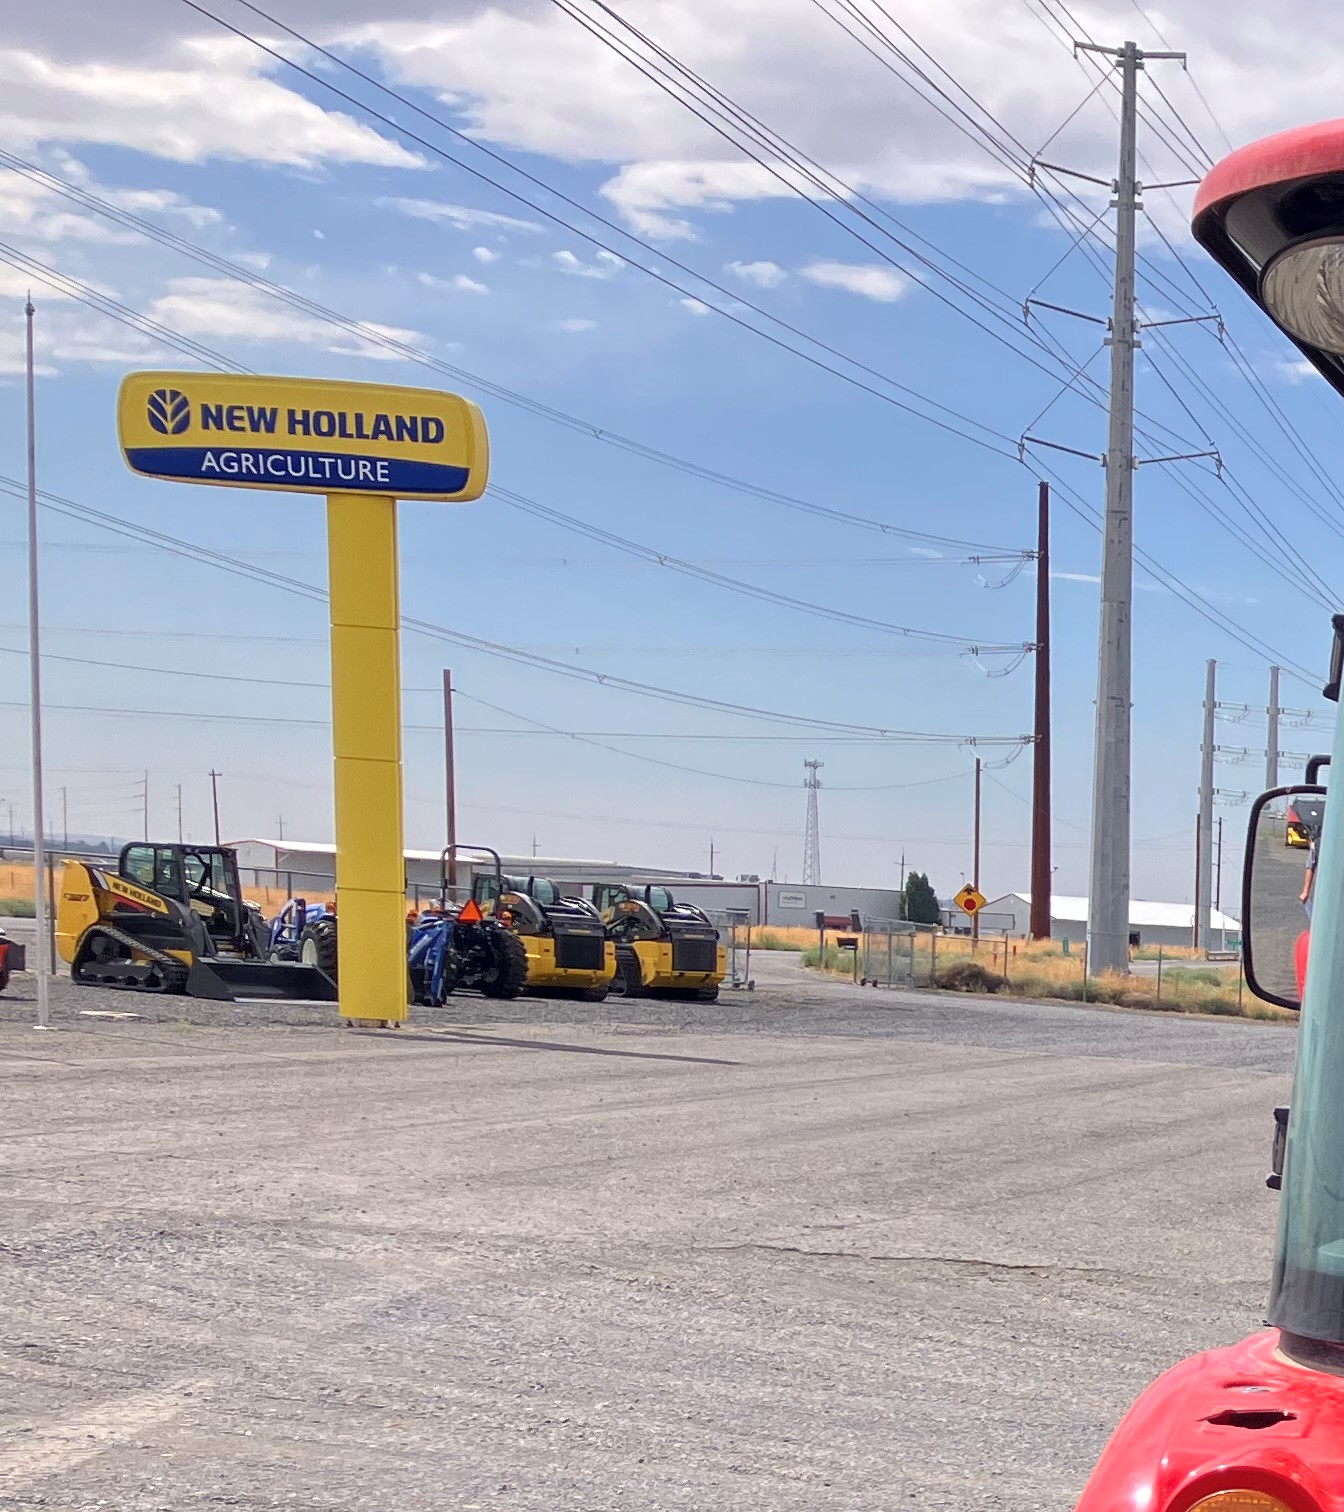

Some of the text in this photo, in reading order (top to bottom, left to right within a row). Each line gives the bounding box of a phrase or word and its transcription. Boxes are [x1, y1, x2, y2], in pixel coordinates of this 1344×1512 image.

[200, 403, 444, 443] NEW HOLLAND
[201, 451, 390, 482] AGRICULTURE
